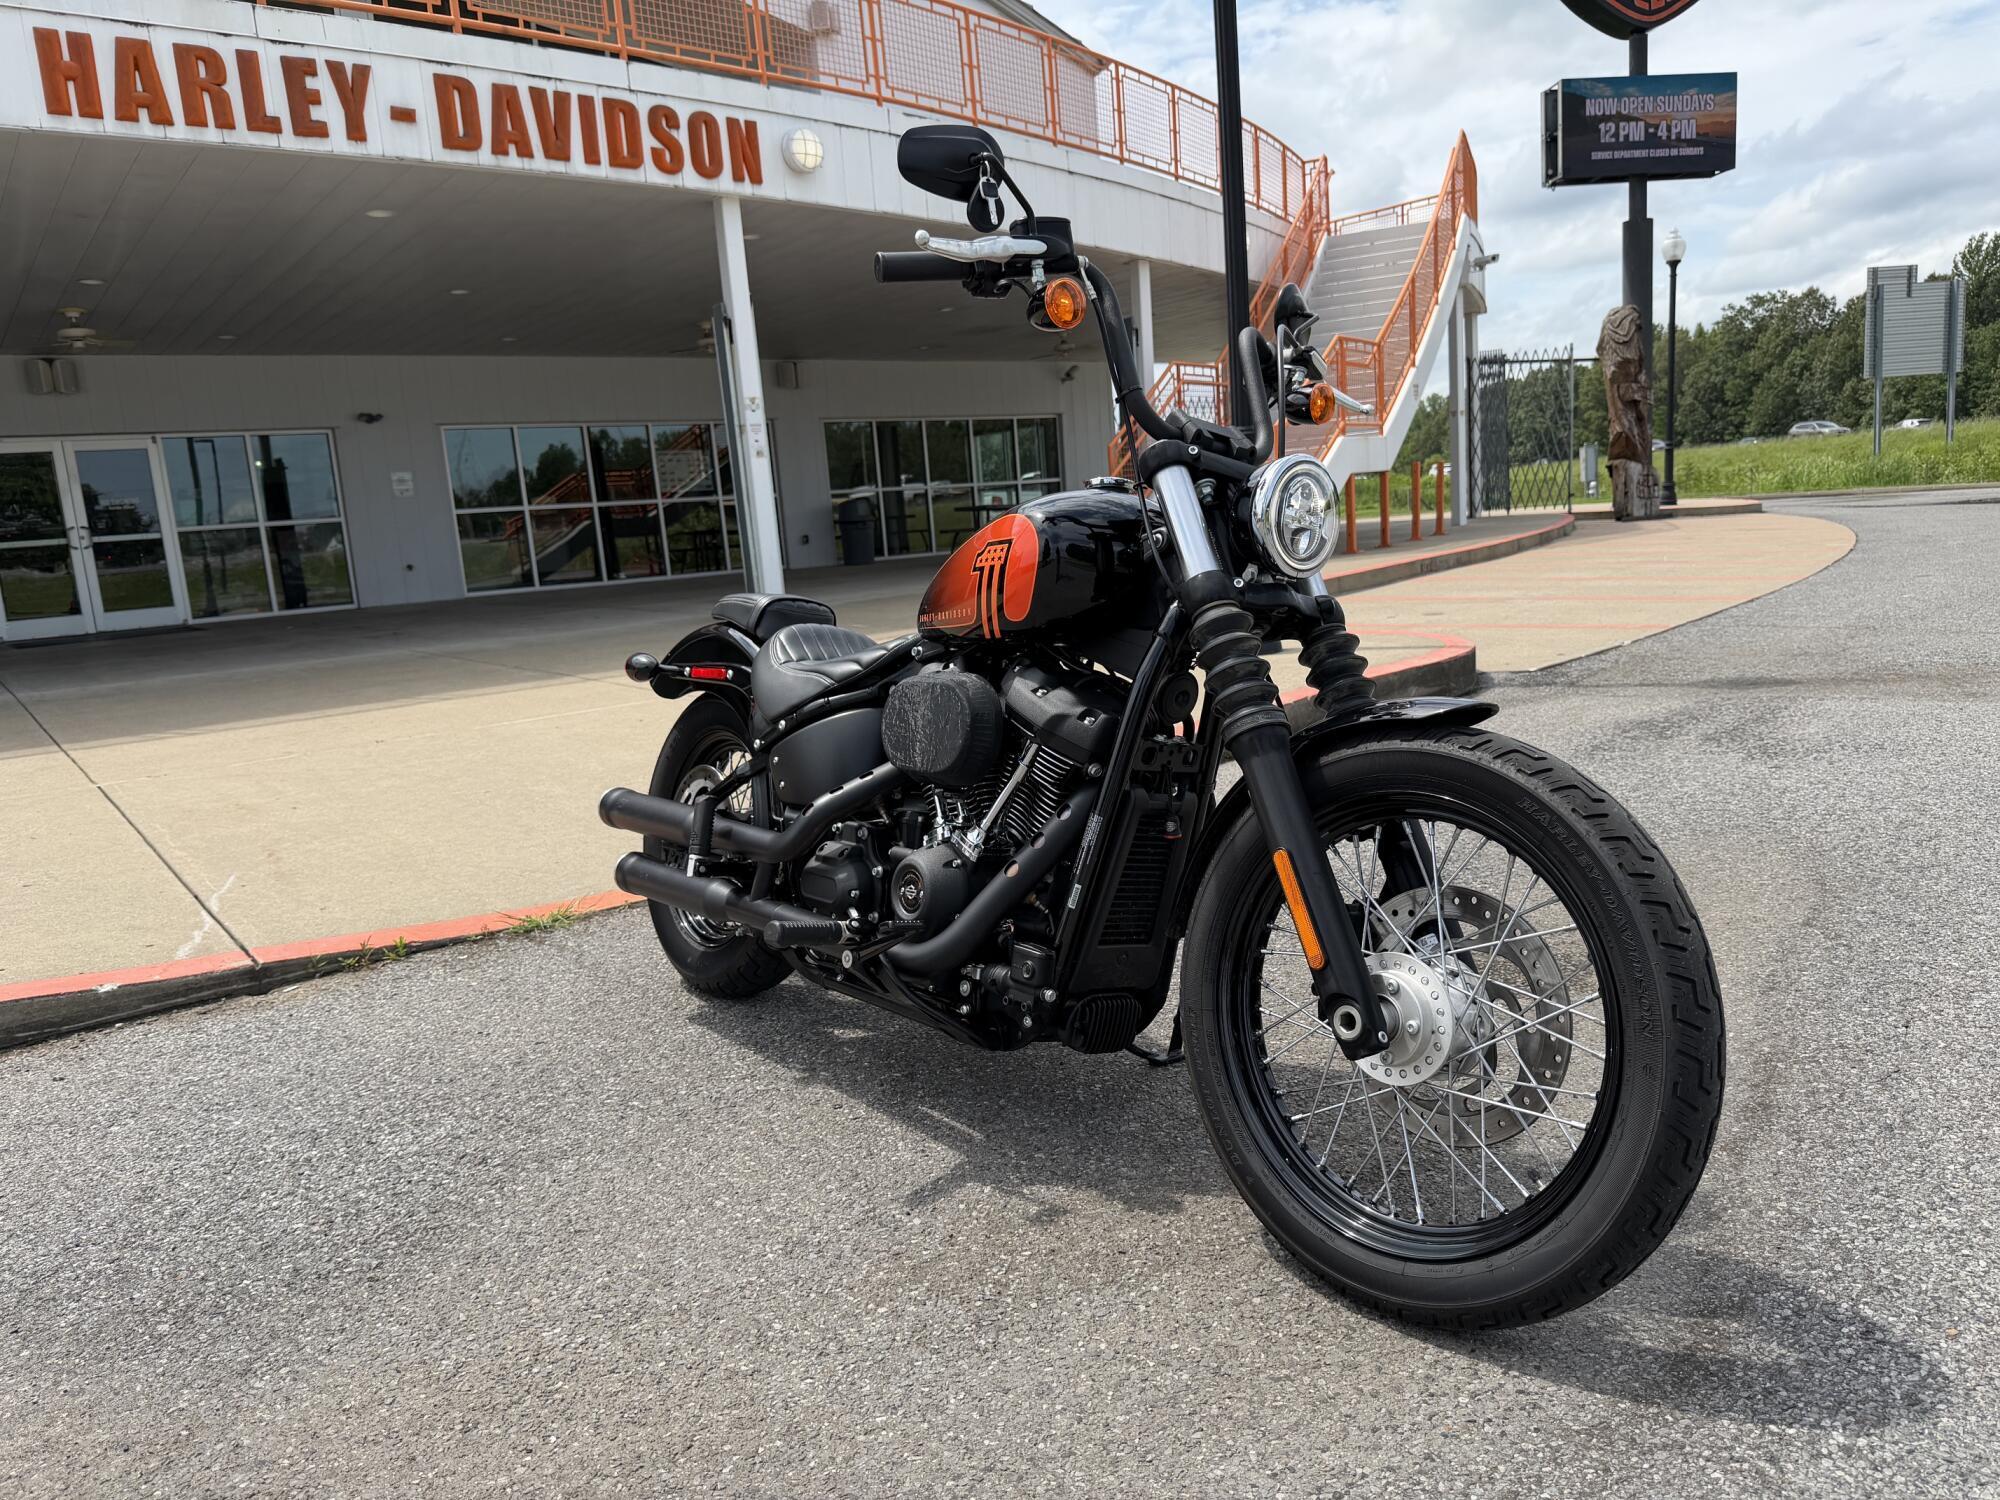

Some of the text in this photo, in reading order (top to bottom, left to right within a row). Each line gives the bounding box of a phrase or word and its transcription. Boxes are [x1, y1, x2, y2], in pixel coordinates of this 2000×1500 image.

[32, 26, 371, 143] HARLEY
[433, 72, 764, 185] DAVIDSON
[1585, 94, 1714, 116] NOW OPEN SUNDAYS
[1598, 122, 1616, 142] 12
[1619, 121, 1645, 141] PM
[1657, 121, 1668, 140] 4
[1671, 119, 1696, 139] PM
[1591, 147, 1704, 160] SERVICE DEPARTMENT CLOSED ON SUNDAYS
